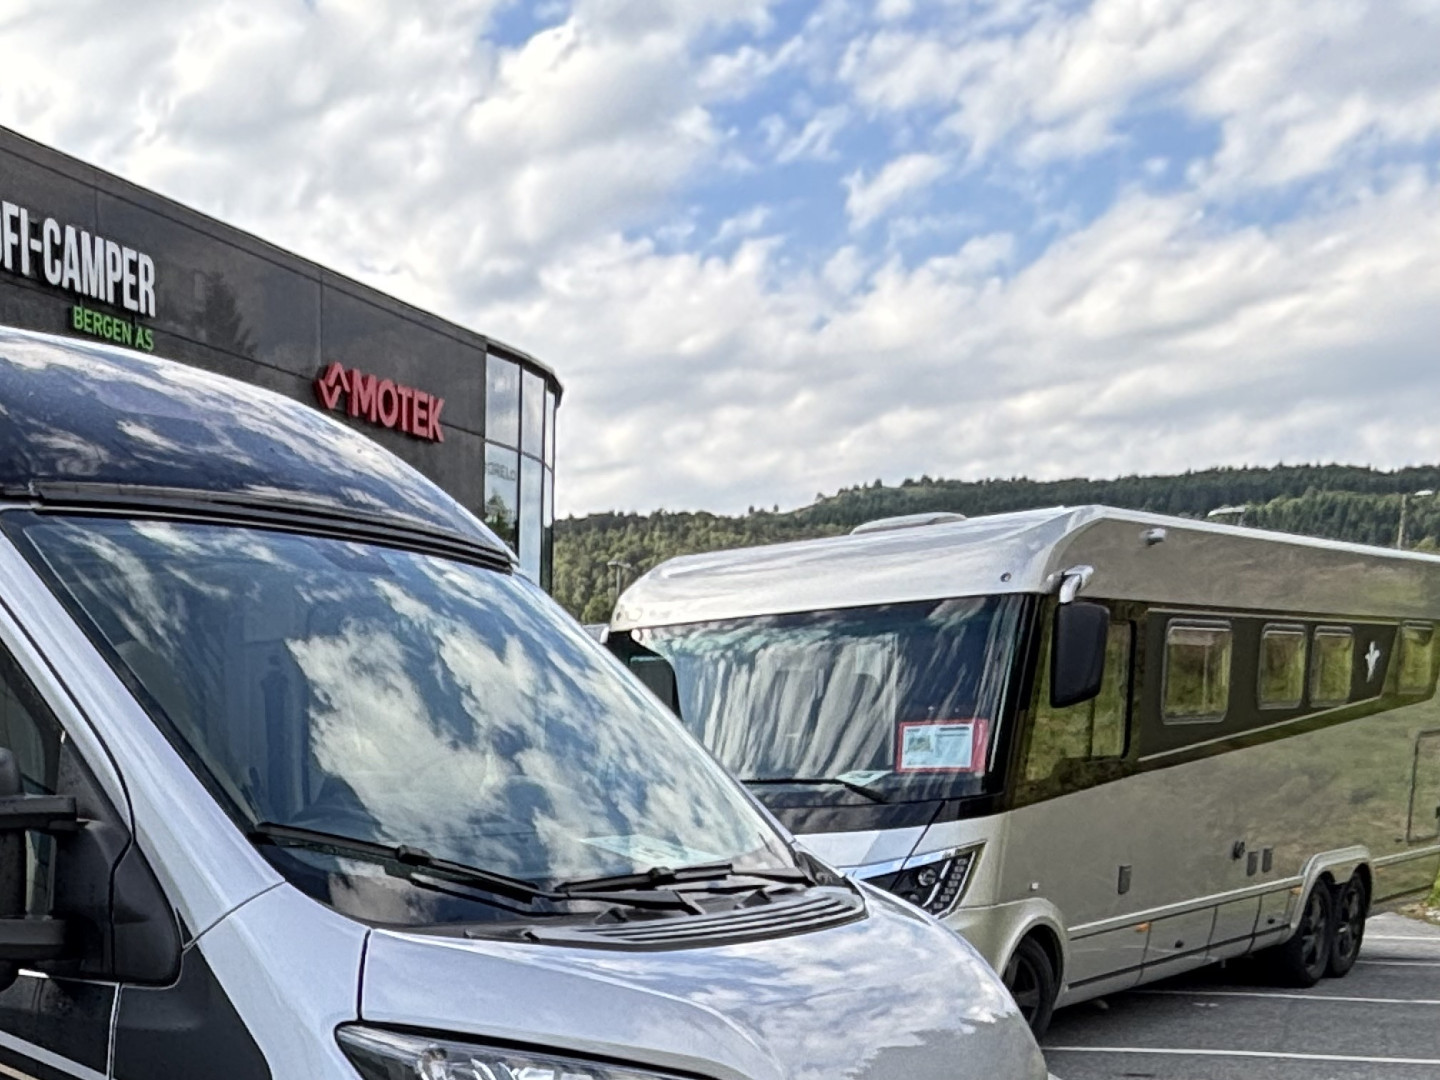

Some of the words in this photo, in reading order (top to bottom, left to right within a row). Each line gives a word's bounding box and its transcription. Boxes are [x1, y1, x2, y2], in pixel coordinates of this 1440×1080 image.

[73, 304, 132, 346] BERGEN
[134, 327, 155, 352] AS
[349, 366, 446, 443] MOTEK
